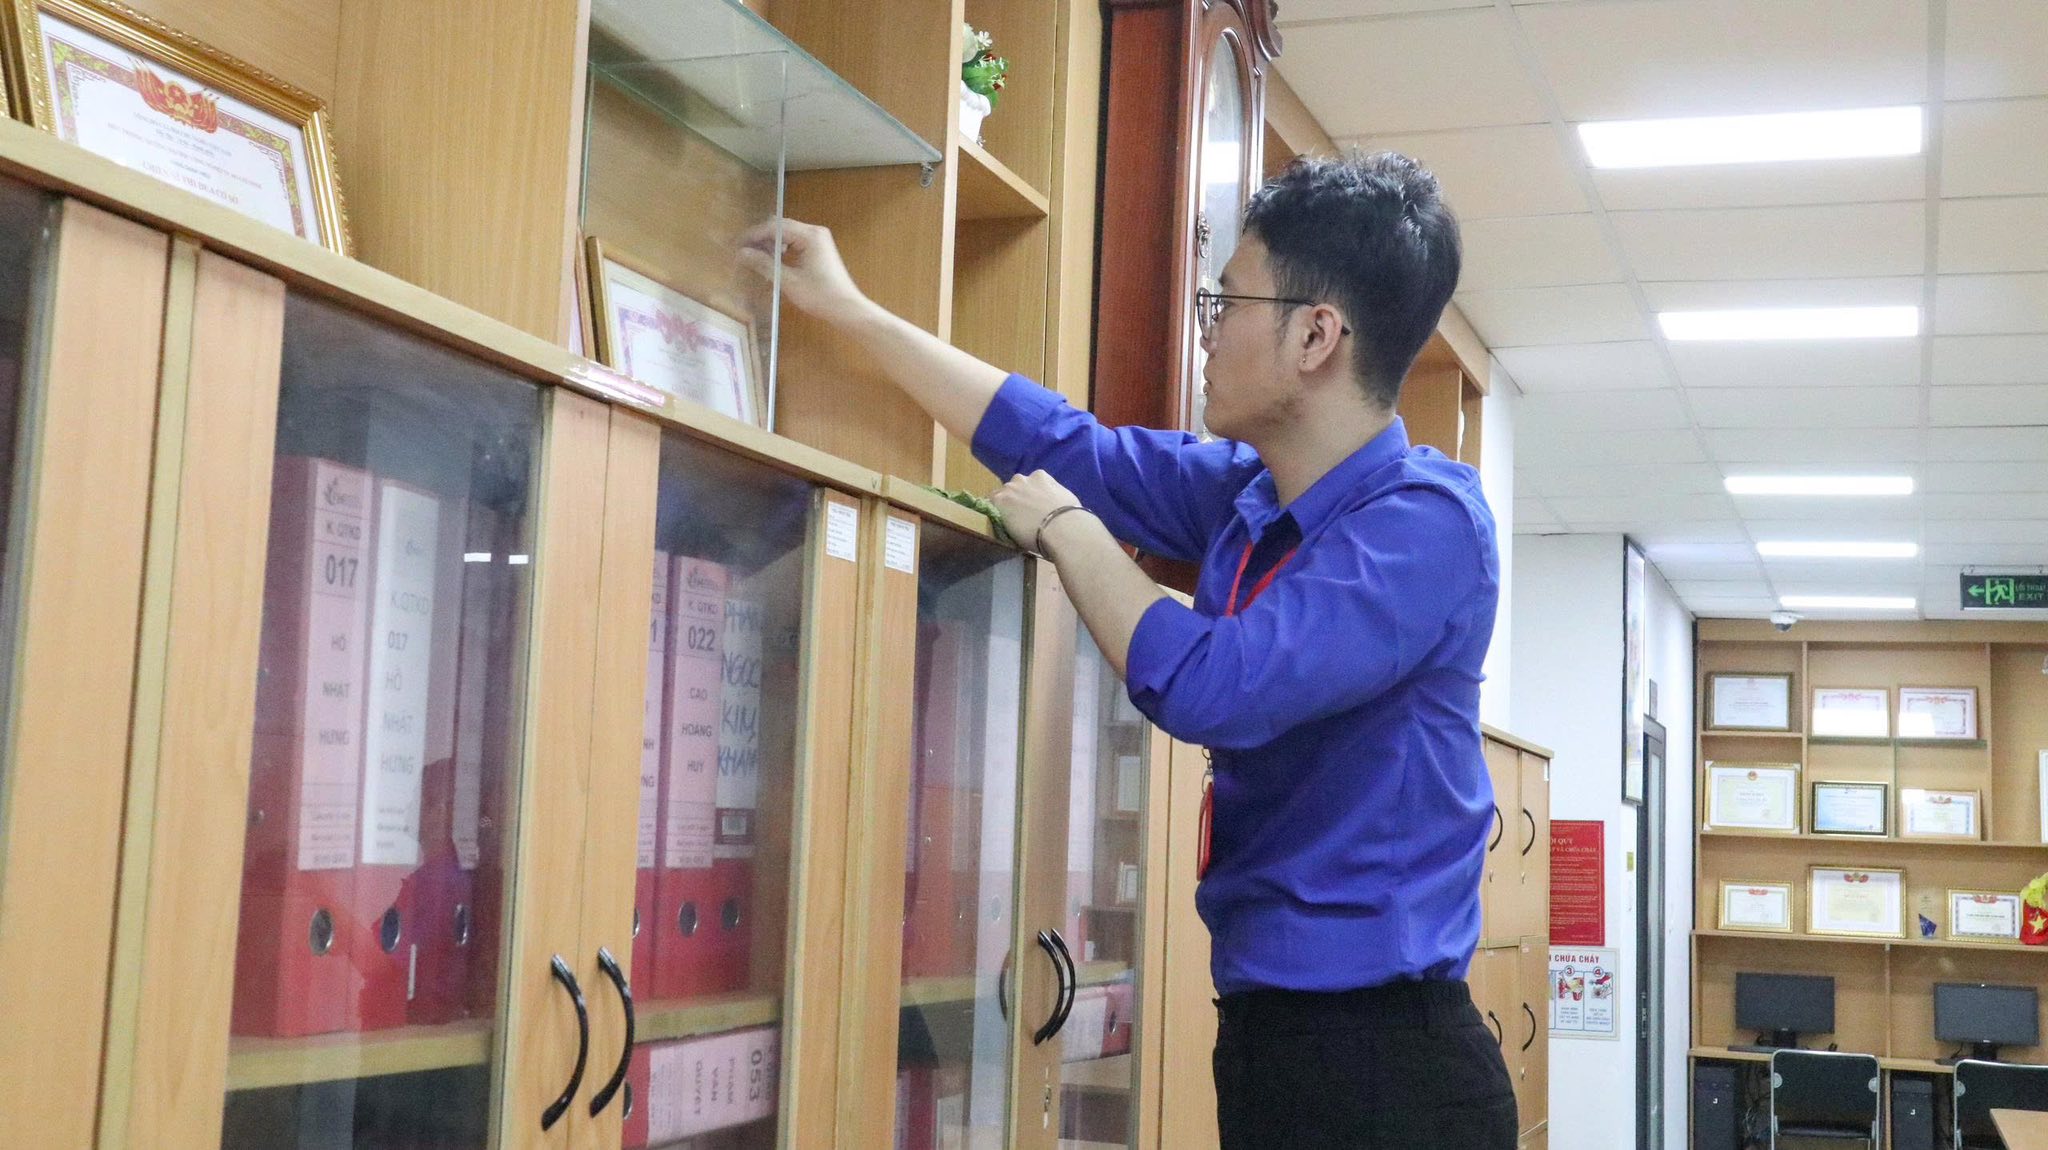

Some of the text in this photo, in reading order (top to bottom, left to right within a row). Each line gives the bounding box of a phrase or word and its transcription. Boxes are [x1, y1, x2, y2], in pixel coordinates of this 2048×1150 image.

[326, 554, 359, 588] 017
[2018, 592, 2044, 601] EXIT
[388, 630, 408, 650] 017
[688, 625, 716, 652] 022
[750, 1049, 763, 1102] 053
